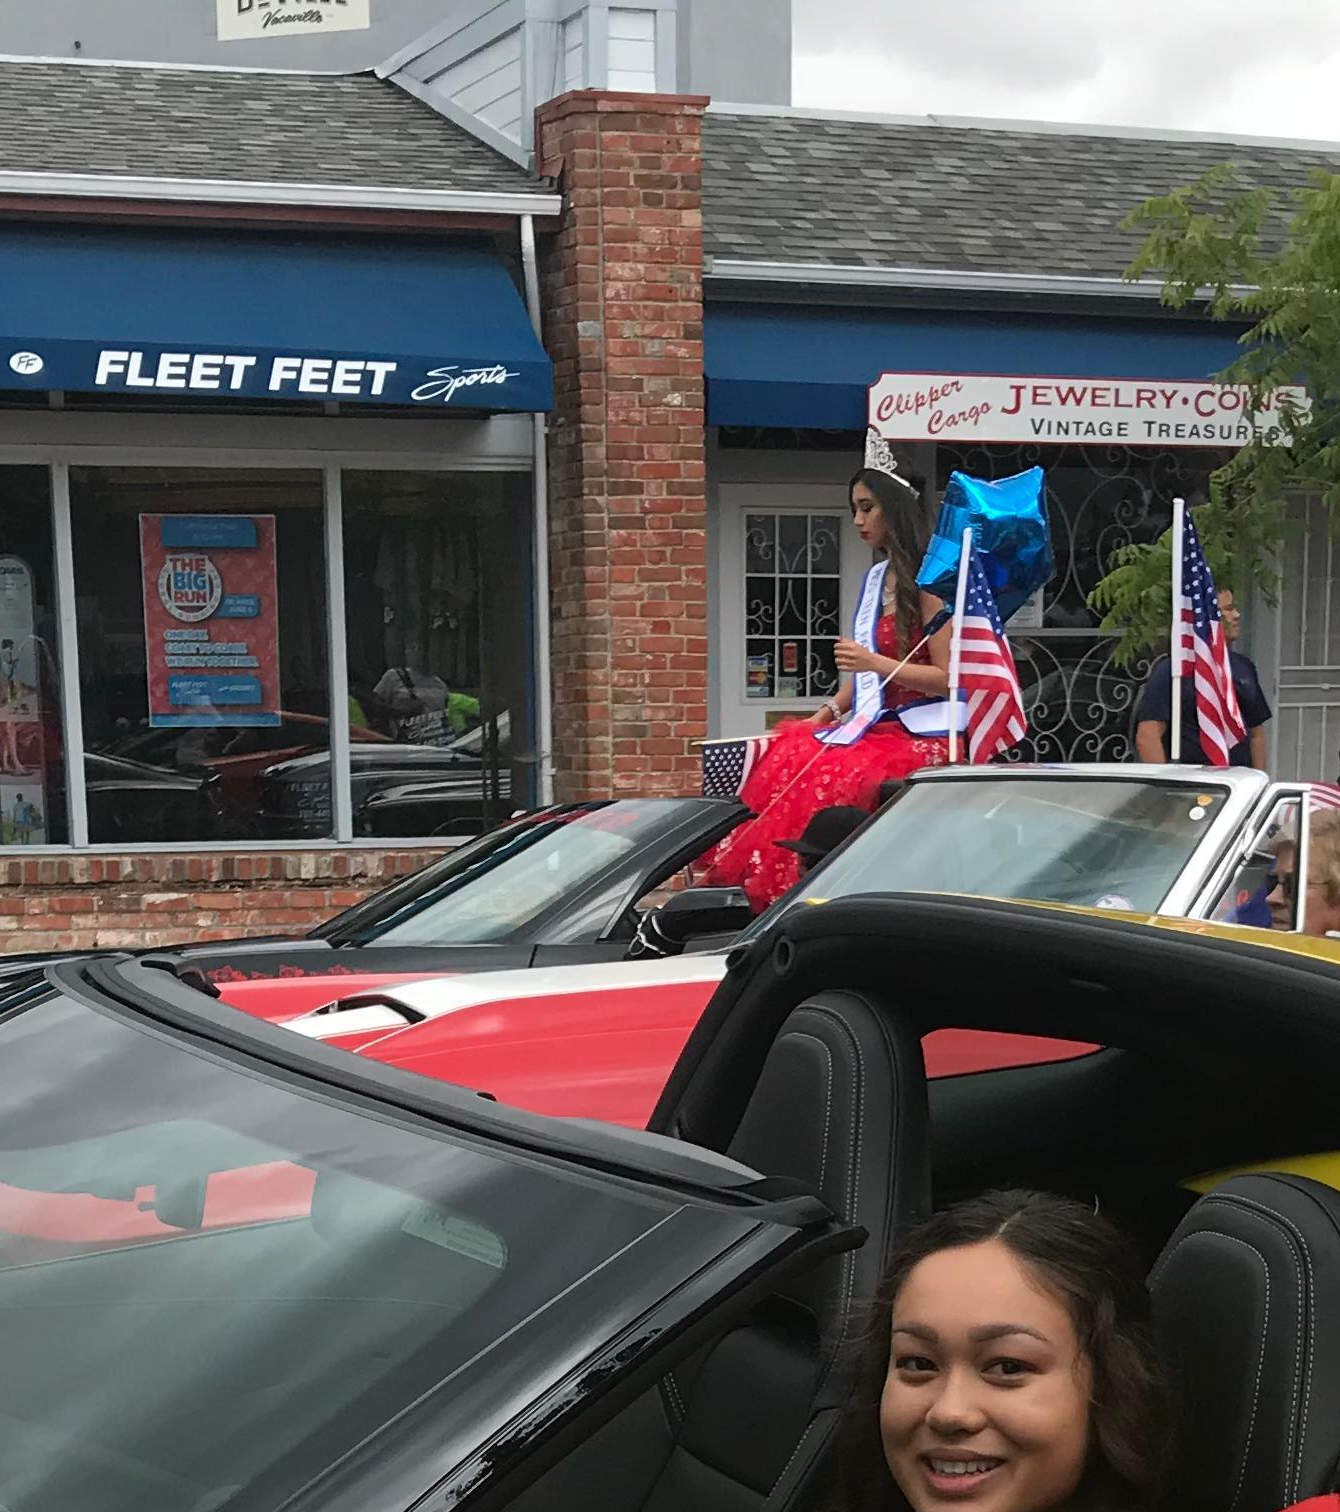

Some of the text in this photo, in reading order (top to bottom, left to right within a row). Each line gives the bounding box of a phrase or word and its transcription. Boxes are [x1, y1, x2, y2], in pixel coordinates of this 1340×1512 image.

[262, 8, 324, 29] Vacaville
[94, 350, 522, 402] FLEET FEET Sports
[875, 380, 964, 422] Clipper
[926, 401, 992, 435] Cargo
[1030, 418, 1130, 437] VINTAGE
[169, 557, 206, 573] THE
[172, 572, 207, 590] BIG
[173, 591, 207, 603] RUN
